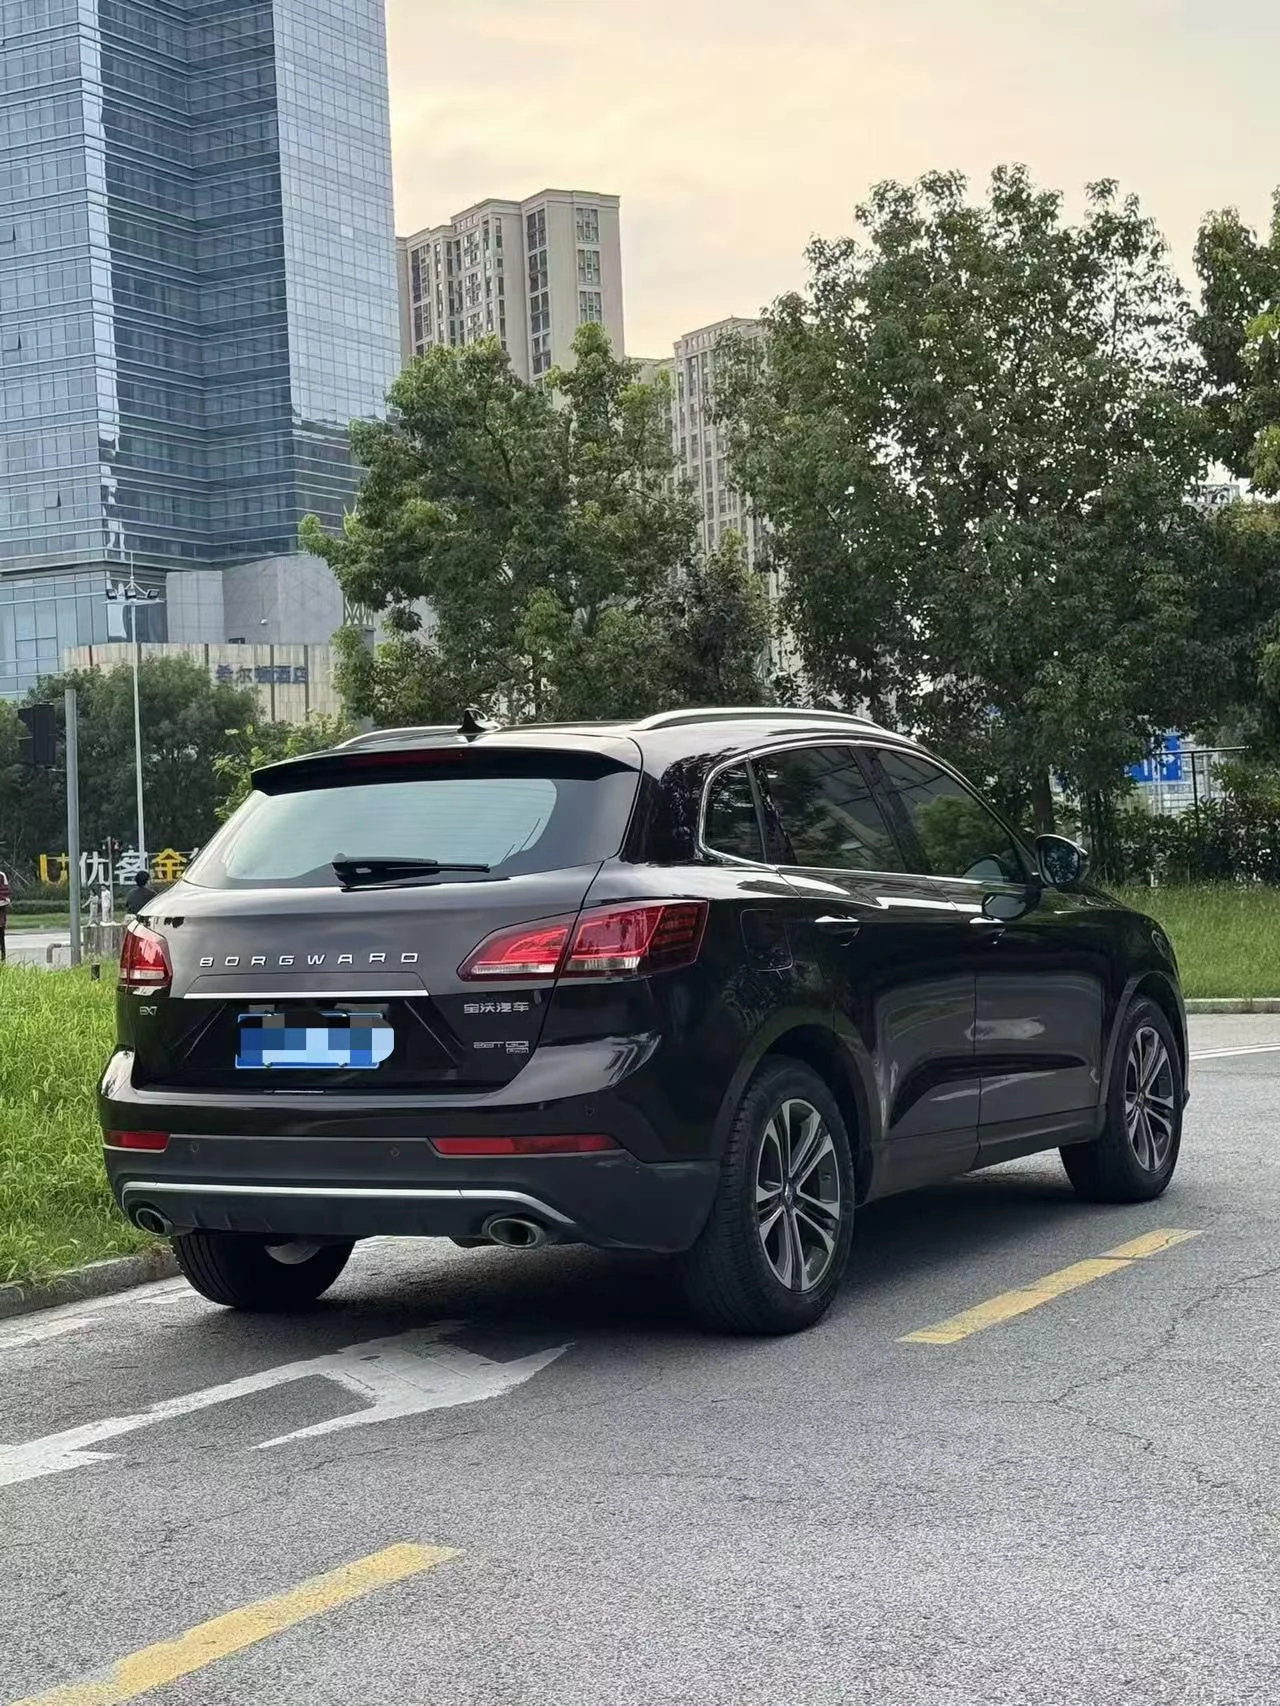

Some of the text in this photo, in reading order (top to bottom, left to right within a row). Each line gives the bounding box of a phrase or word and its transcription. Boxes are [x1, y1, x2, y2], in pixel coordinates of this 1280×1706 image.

[199, 952, 419, 967] BORGWARD
[463, 1001, 529, 1014] 宝沃汽车
